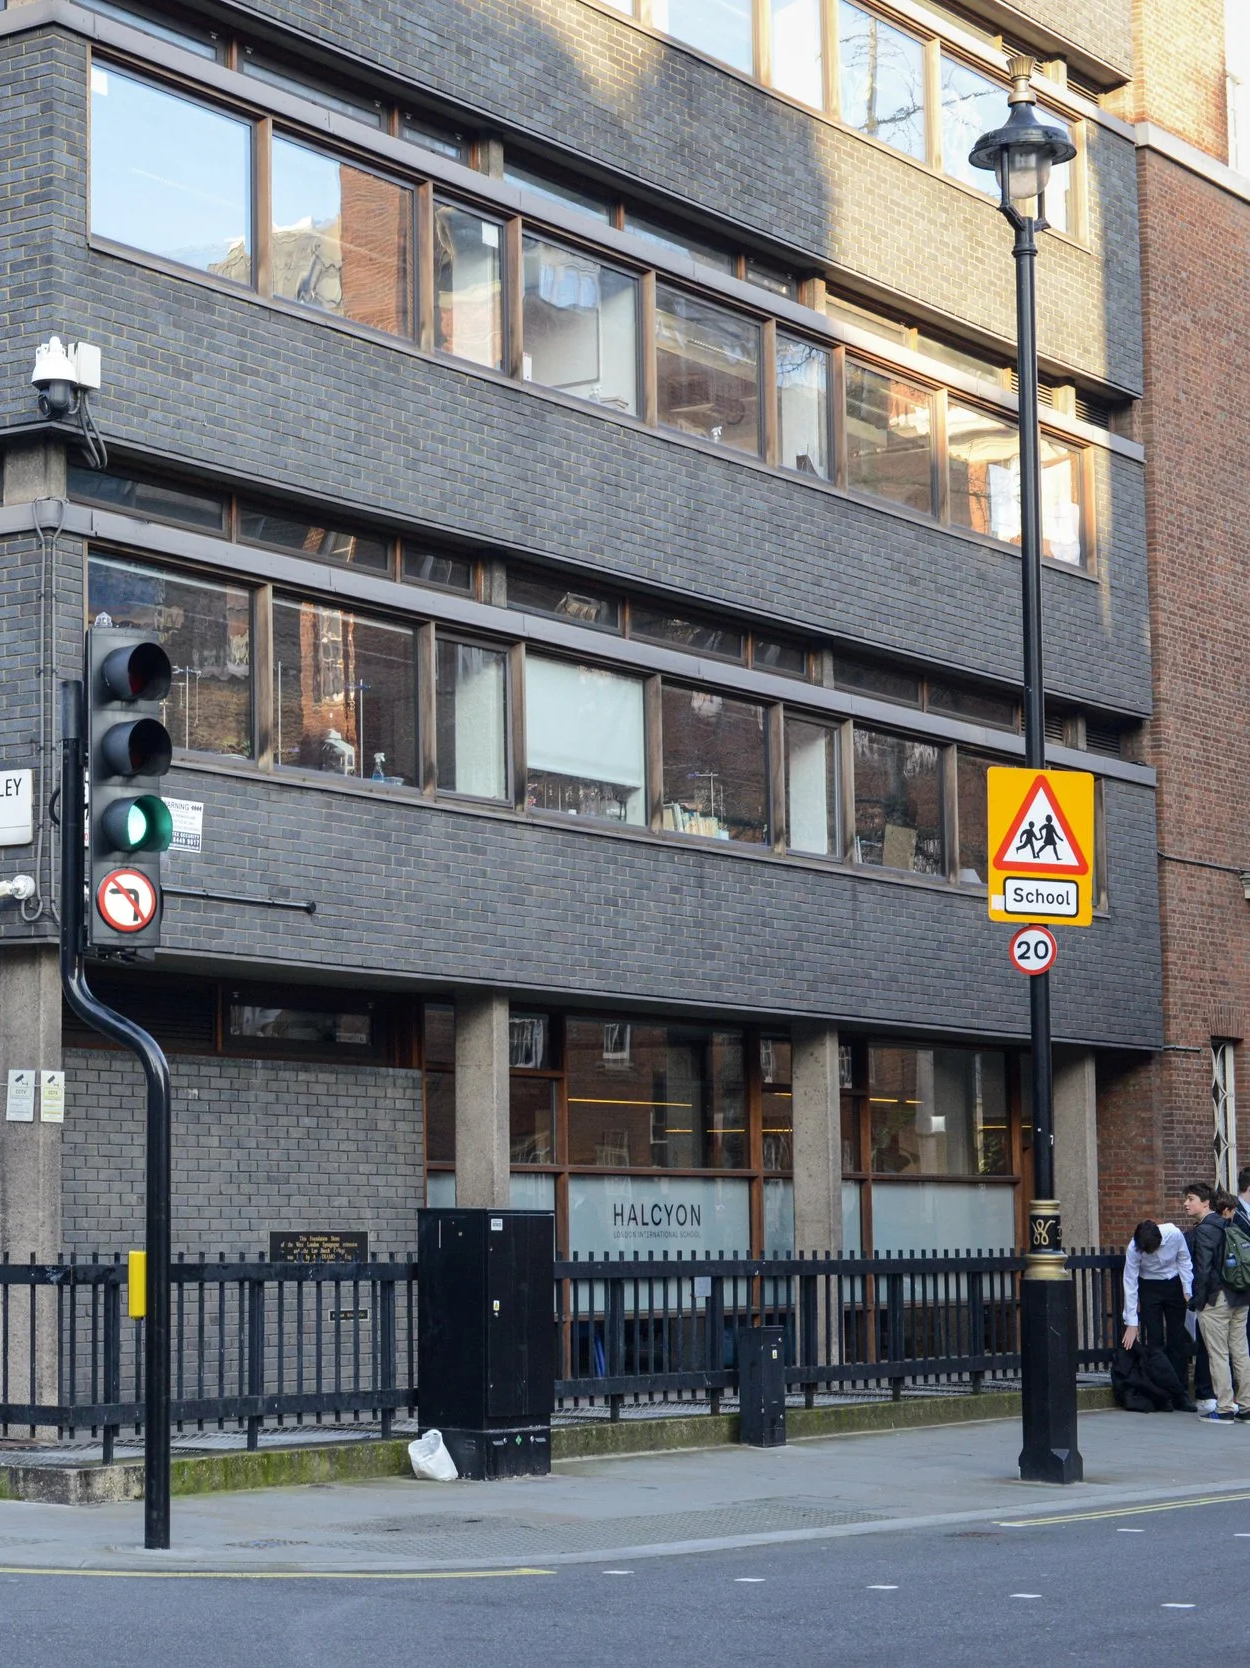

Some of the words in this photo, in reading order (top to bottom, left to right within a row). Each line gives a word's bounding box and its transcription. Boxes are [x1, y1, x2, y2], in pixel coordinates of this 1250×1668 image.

[167, 801, 190, 811] ARNING
[1013, 887, 1071, 906] School
[1016, 940, 1049, 960] 20
[613, 1203, 701, 1226] HALCYON
[638, 1231, 678, 1239] INTERNATIONAL
